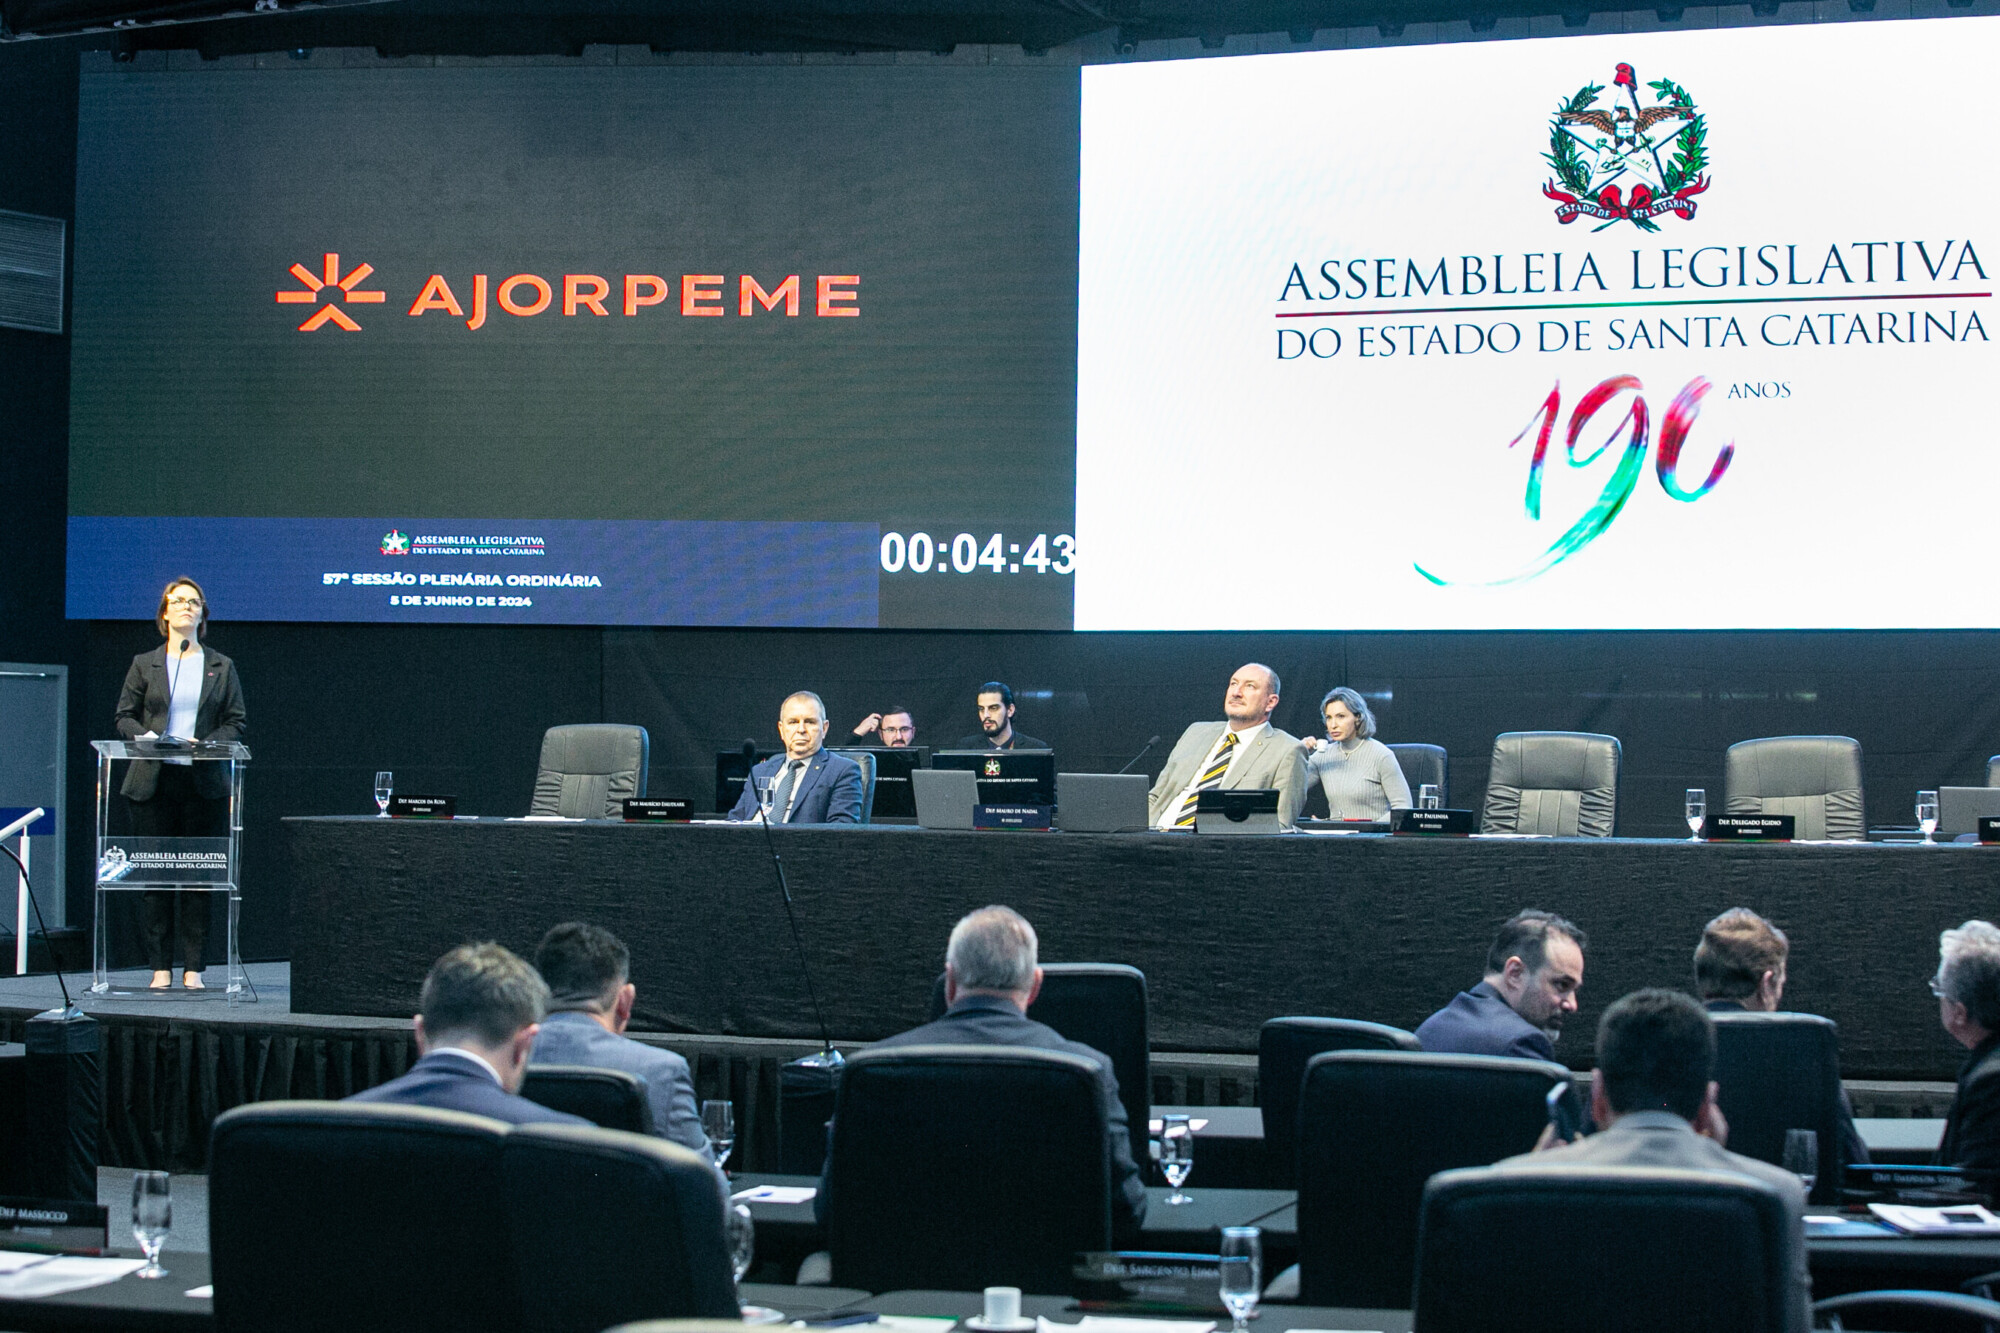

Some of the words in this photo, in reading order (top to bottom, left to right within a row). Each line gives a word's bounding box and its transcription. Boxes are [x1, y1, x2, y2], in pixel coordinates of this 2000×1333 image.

[1558, 203, 1596, 216] ESTADO
[1597, 208, 1611, 218] DE
[1277, 251, 1610, 301] ASSEMBLEIA
[1630, 239, 1991, 290] LEGISLATIVA
[407, 273, 861, 330] AJORPEME
[1277, 327, 1342, 360] DO
[1358, 322, 1521, 357] ESTADO
[1538, 320, 1592, 352] DE
[1607, 316, 1748, 351] SANTA
[1761, 310, 1991, 347] CATARINA
[1728, 381, 1792, 399] ANOS
[1413, 374, 1735, 586] 190
[413, 535, 478, 545] ASSEMBLEIA
[479, 536, 545, 546] LEGISLATIVA
[412, 547, 427, 555] DO
[428, 547, 460, 555] ESTADO
[461, 547, 474, 555] DE
[503, 548, 545, 556] CATARINA
[880, 532, 1075, 574] 00:04:43
[351, 571, 417, 585] SESSÃO
[420, 572, 504, 586] PLENÁRIA
[506, 573, 602, 587] ORDINÁRIA
[390, 595, 400, 605] 5
[401, 595, 422, 605] DE
[423, 596, 473, 606] JUNHO
[475, 596, 497, 606] DE
[498, 596, 532, 607] 2024
[129, 852, 176, 860] ASSEMBLEIA
